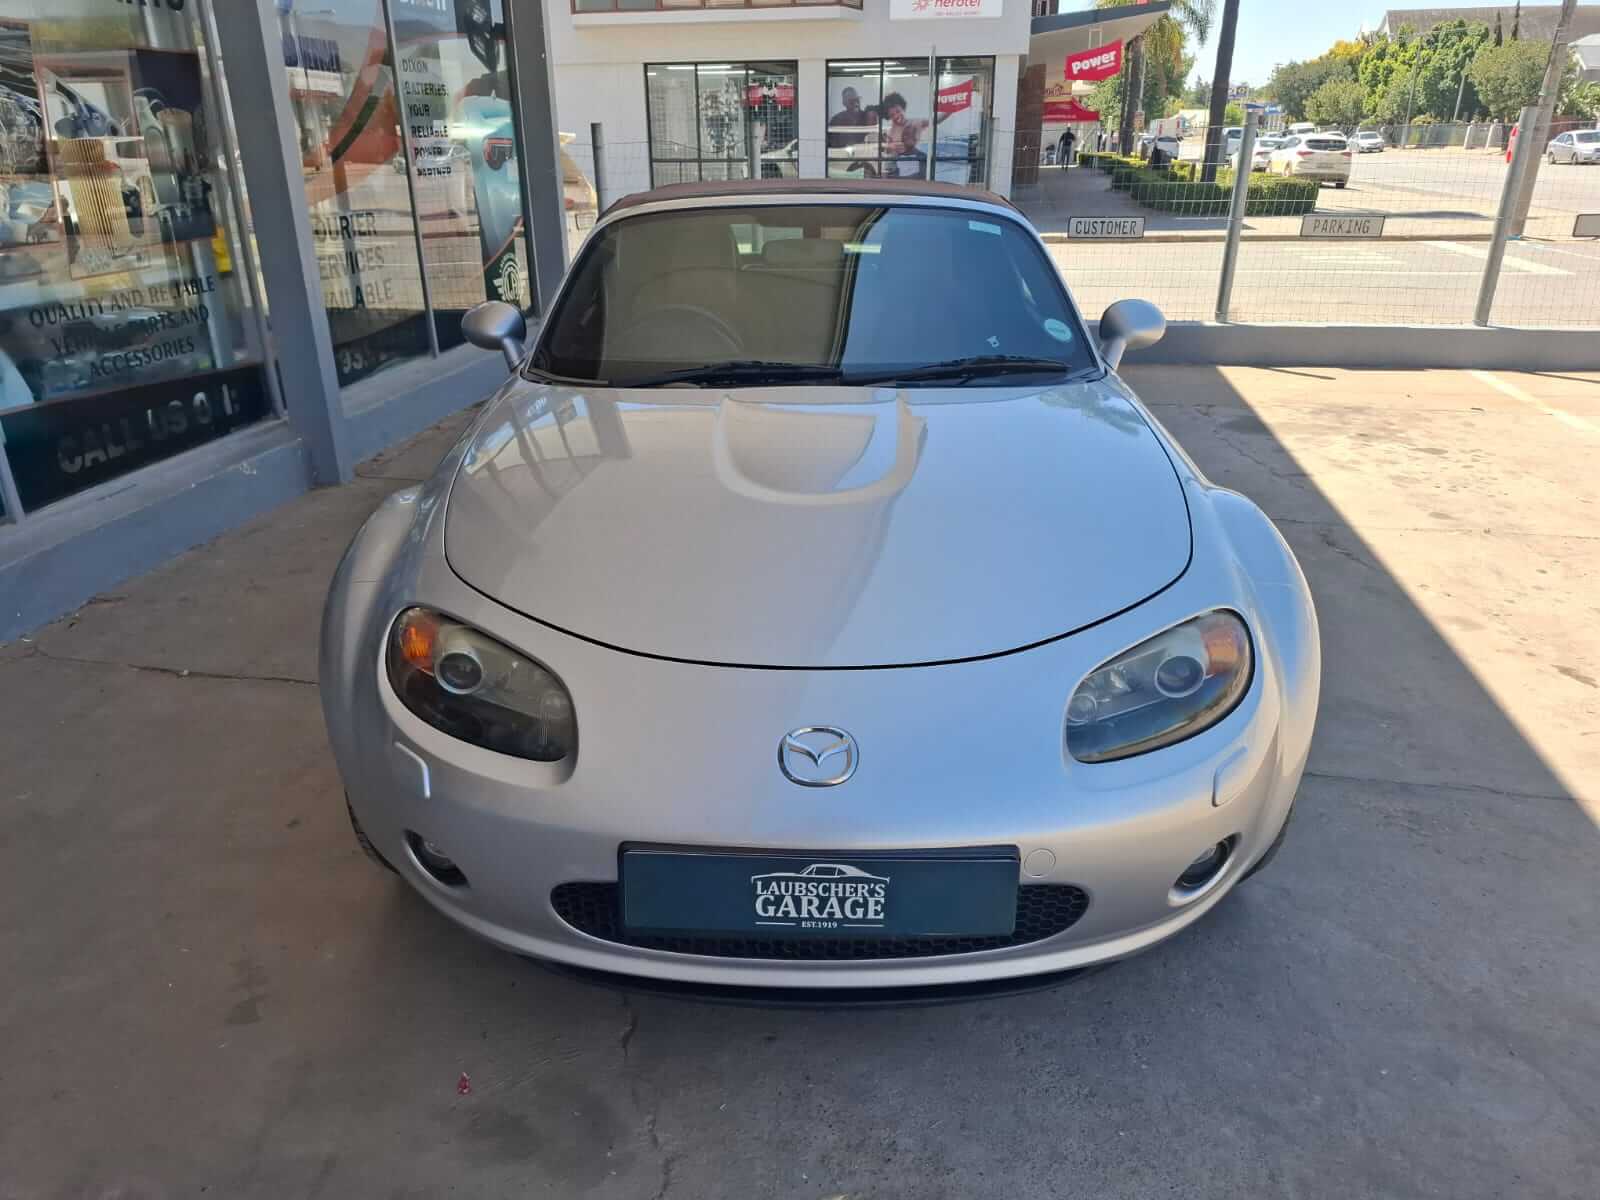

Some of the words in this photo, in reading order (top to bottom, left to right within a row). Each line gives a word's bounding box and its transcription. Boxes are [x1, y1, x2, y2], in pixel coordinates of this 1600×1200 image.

[408, 103, 431, 119] YOUR
[411, 125, 449, 138] RELIABLE
[414, 145, 442, 160] POWER
[1075, 220, 1137, 235] CUSTOMER
[1312, 218, 1371, 234] PARKING
[29, 297, 106, 329] QUALITY
[110, 289, 144, 312] AND
[181, 303, 209, 326] AND
[89, 336, 195, 378] ACCESSORIES
[756, 881, 885, 898] LAUBSCHER'S
[755, 895, 885, 919] GARAGE
